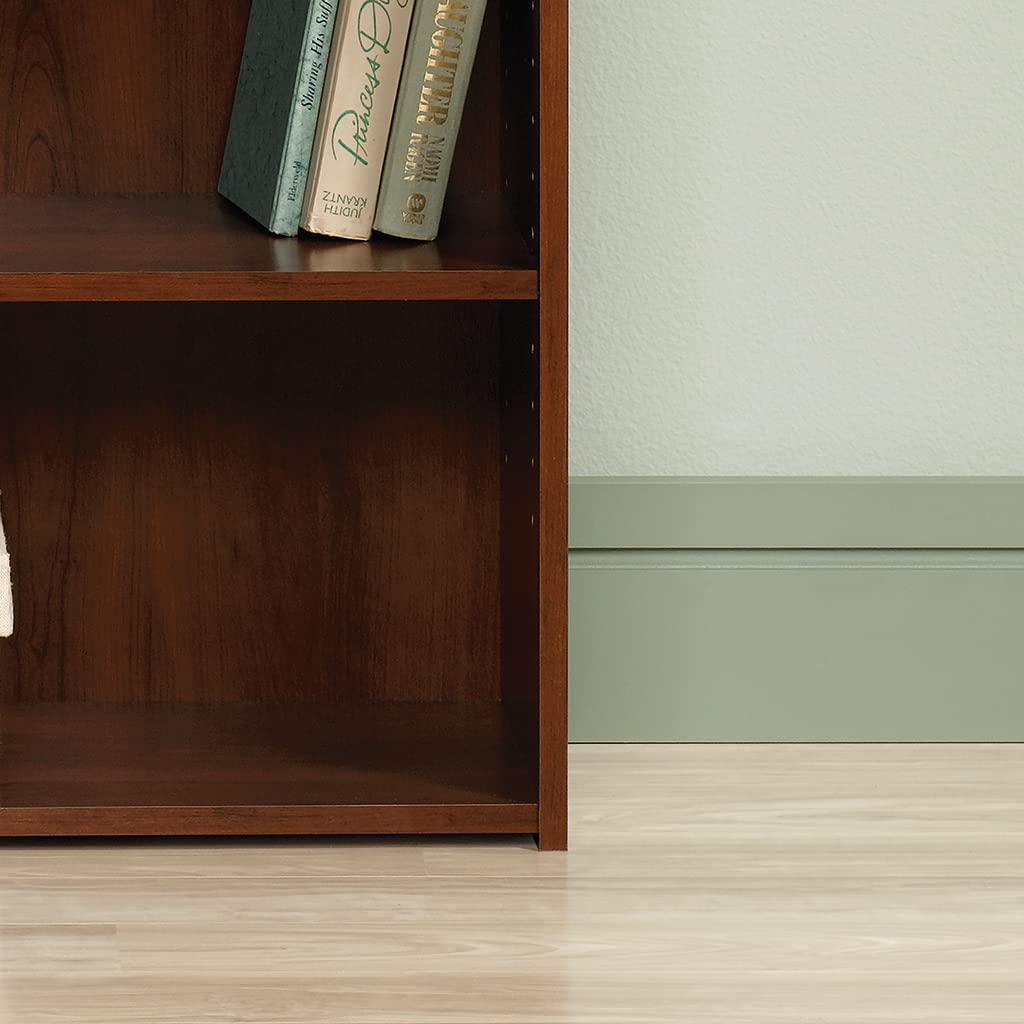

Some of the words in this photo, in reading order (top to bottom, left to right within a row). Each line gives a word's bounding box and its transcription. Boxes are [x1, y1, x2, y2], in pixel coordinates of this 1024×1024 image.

[310, 33, 326, 57] His
[301, 61, 323, 111] Sharing
[332, 54, 381, 166] Princess
[322, 190, 368, 207] KRANTZ
[323, 203, 363, 218] JUDITH
